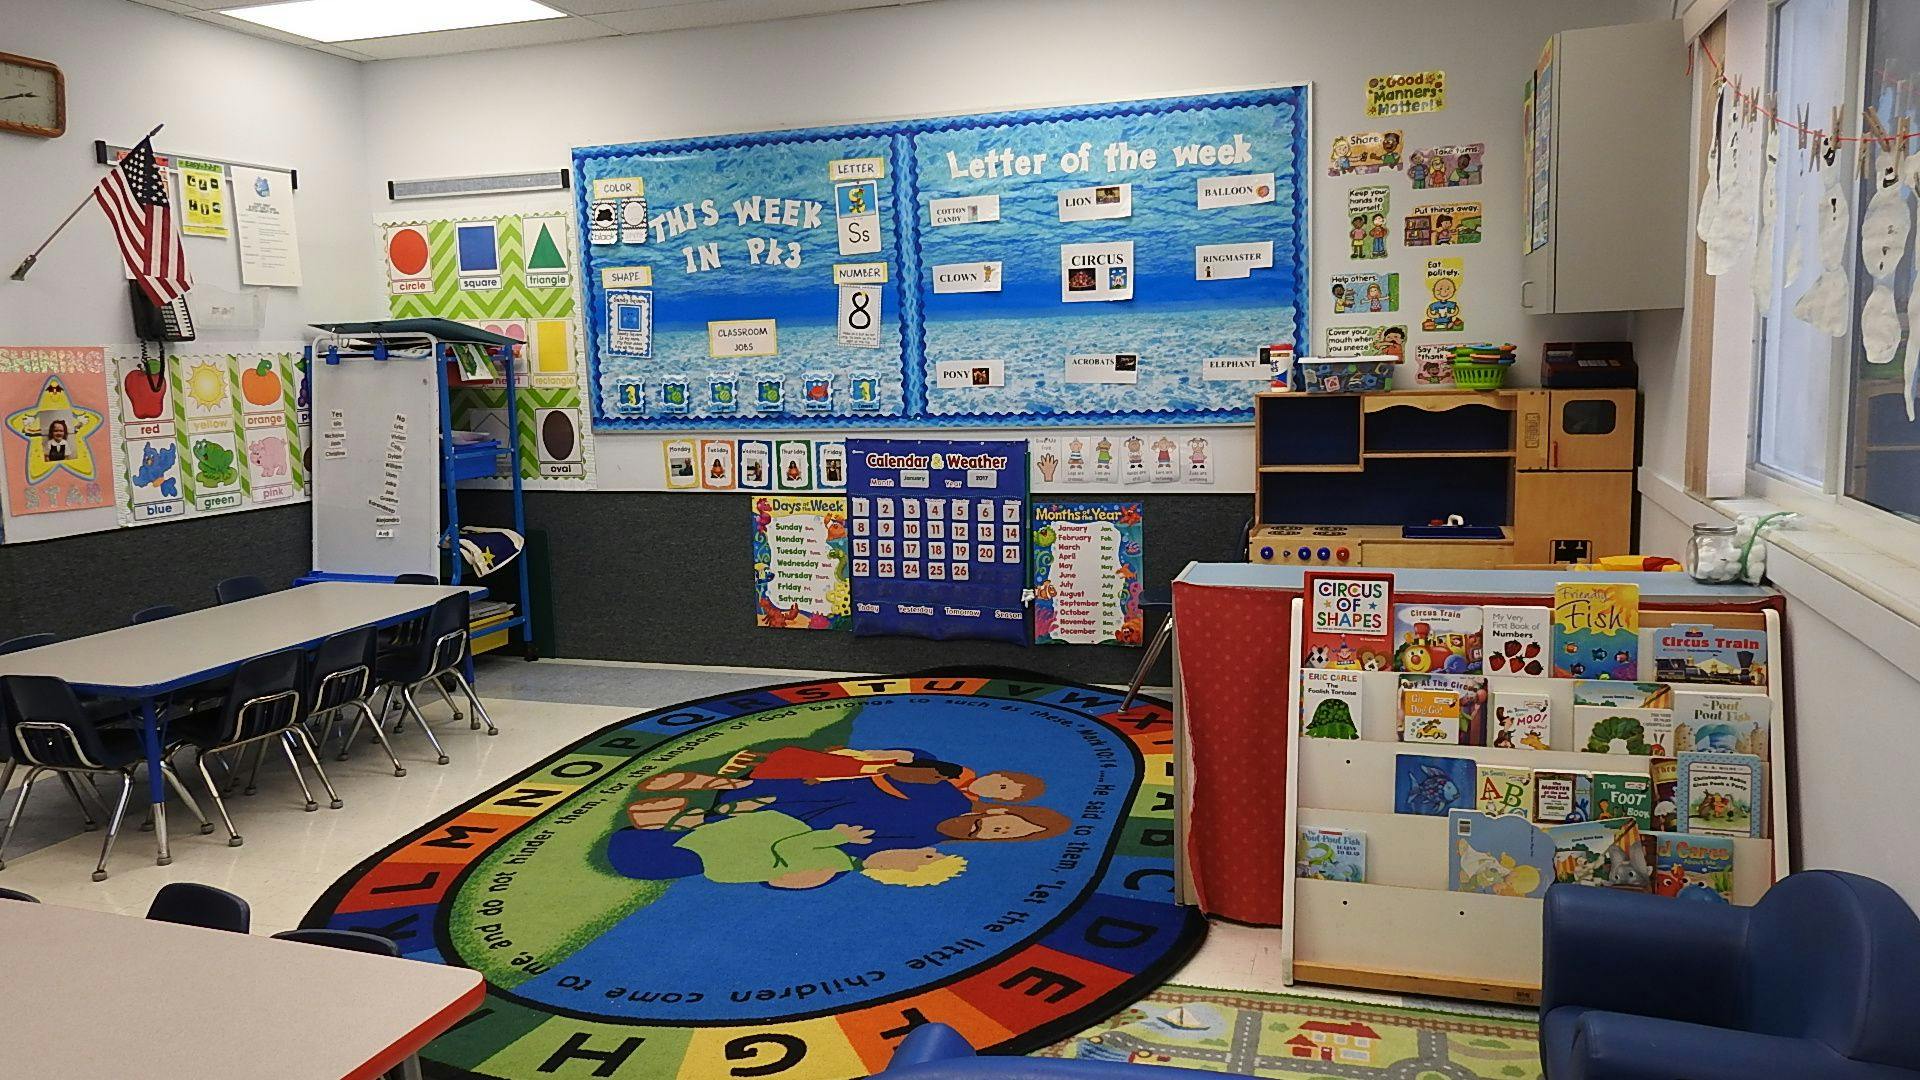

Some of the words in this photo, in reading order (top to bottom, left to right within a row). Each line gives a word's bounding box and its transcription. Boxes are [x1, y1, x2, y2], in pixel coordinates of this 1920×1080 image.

[1386, 74, 1424, 88] Good
[1374, 87, 1436, 102] Manners
[1378, 100, 1434, 115] Matter!
[947, 147, 1047, 178] Letter
[1060, 143, 1091, 172] of
[1104, 141, 1157, 172] the
[1172, 134, 1253, 167] week
[838, 164, 874, 174] LETTER
[603, 183, 633, 193] COLOR
[1204, 185, 1253, 197] BALLOON
[1350, 189, 1368, 198] Keep
[1371, 189, 1387, 198] your
[1065, 197, 1091, 207] LION
[936, 207, 966, 215] COTTON
[1350, 204, 1382, 213] yourself.
[1431, 206, 1454, 214] things
[651, 200, 719, 242] THIS
[733, 197, 822, 228] WEEK
[937, 215, 961, 223] CANDY
[849, 223, 870, 244] Ss
[683, 242, 721, 273] IN
[747, 238, 801, 268] Pk3
[1071, 254, 1124, 266] CIRCUS
[1203, 252, 1262, 263] RINGMASTER
[612, 272, 641, 282] SHAPE
[839, 268, 881, 278] NUMBER
[939, 272, 978, 283] CLOWN
[1428, 269, 1460, 278] politely.
[464, 278, 497, 288] square
[529, 276, 566, 285] triangle
[1332, 276, 1349, 284] Help
[400, 282, 426, 291] circle
[849, 291, 871, 329] 8
[718, 328, 768, 337] CLASSROOM
[0, 350, 102, 374] SHINING
[1209, 360, 1256, 368] ELEPHANT
[943, 370, 969, 379] PONY
[535, 376, 575, 385] rectangle
[194, 419, 228, 430] yellow
[246, 414, 282, 426] orange
[141, 424, 160, 434] red
[708, 446, 728, 454] Tuesday
[867, 454, 929, 469] Calendar
[931, 454, 944, 469] &
[947, 455, 1006, 469] Weather
[550, 465, 571, 473] oval
[870, 479, 894, 487] Month
[23, 483, 103, 510] STAR
[262, 487, 284, 498] pink
[204, 495, 234, 509] green
[773, 501, 801, 514] Days
[811, 500, 843, 512] Week
[146, 504, 172, 516] blue
[1036, 508, 1080, 520] Months
[1092, 508, 1121, 520] Year
[776, 523, 802, 532] Sunday
[858, 523, 864, 532] 8
[884, 523, 889, 532] 9
[906, 526, 917, 534] 10
[932, 525, 939, 534] 11
[954, 526, 965, 536] 12
[981, 527, 991, 537] 13
[1006, 528, 1017, 538] 14
[1058, 525, 1087, 533] January
[776, 536, 804, 544] Monday
[777, 547, 806, 556] Tuesday
[777, 560, 818, 568] Wednesday
[778, 571, 812, 580] Thursday
[778, 583, 801, 592] Friday
[1059, 581, 1073, 589] July
[1319, 582, 1382, 598] CIRCUS
[778, 595, 812, 604] Saturday
[1558, 587, 1608, 602] Friendly
[1060, 600, 1099, 608] September
[1336, 600, 1361, 612] OF
[858, 604, 879, 612] Today
[899, 605, 933, 615] Yesterday
[945, 608, 980, 617] Tomorrow
[995, 611, 1022, 619] Season
[1440, 610, 1461, 618] Train
[1556, 600, 1624, 630] Fish
[1317, 612, 1382, 628] SHAPES
[1662, 637, 1709, 647] Circus
[1715, 638, 1759, 649] Train
[1330, 674, 1357, 682] CARLE
[1308, 688, 1330, 696] Foolish
[1517, 714, 1547, 725] MOO!
[652, 730, 723, 763] kingdom
[628, 763, 657, 778] the
[601, 782, 628, 795] for
[1611, 792, 1646, 804] FOOT
[1628, 808, 1649, 818] BOOK
[507, 829, 554, 870] hinder
[490, 872, 515, 892] not
[478, 899, 502, 917] do
[476, 921, 513, 950] and
[1085, 917, 1158, 948] D
[905, 938, 986, 969] little
[557, 975, 592, 991] to
[730, 970, 884, 1002] children
[1000, 967, 1086, 1004] E
[605, 987, 704, 1003] come
[537, 1032, 646, 1077] H
[725, 1033, 807, 1077] G
